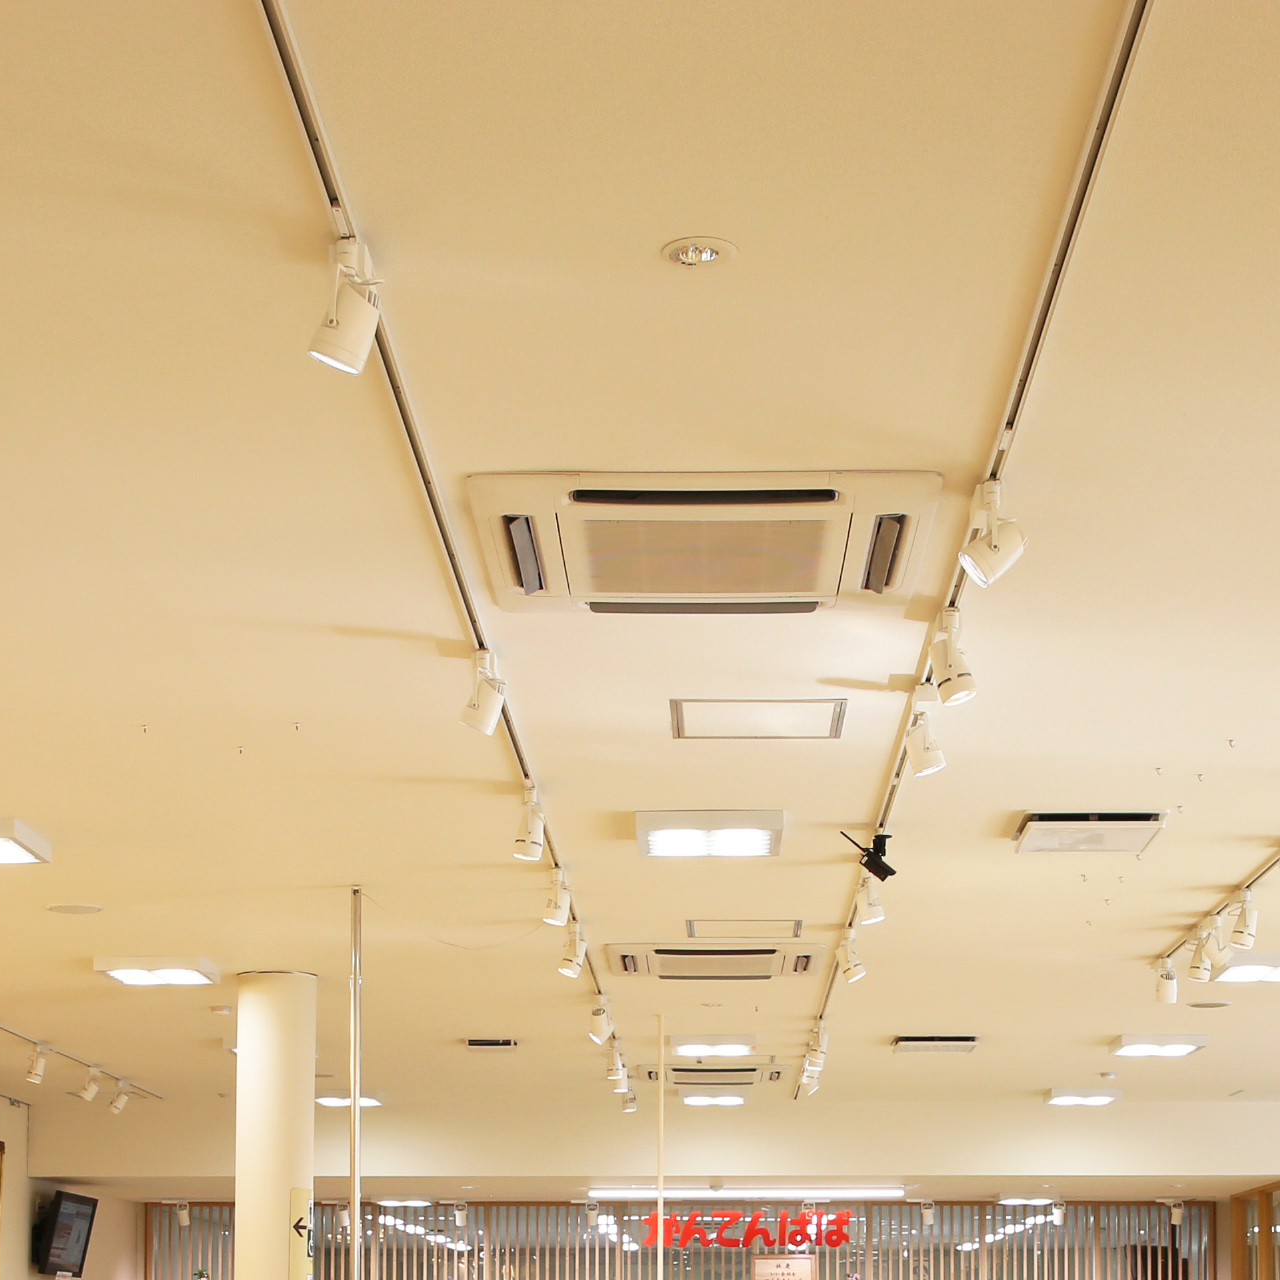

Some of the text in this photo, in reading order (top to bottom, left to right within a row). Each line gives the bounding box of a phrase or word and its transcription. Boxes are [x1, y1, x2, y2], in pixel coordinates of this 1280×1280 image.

[642, 1209, 852, 1248] かんてんぱぱ
